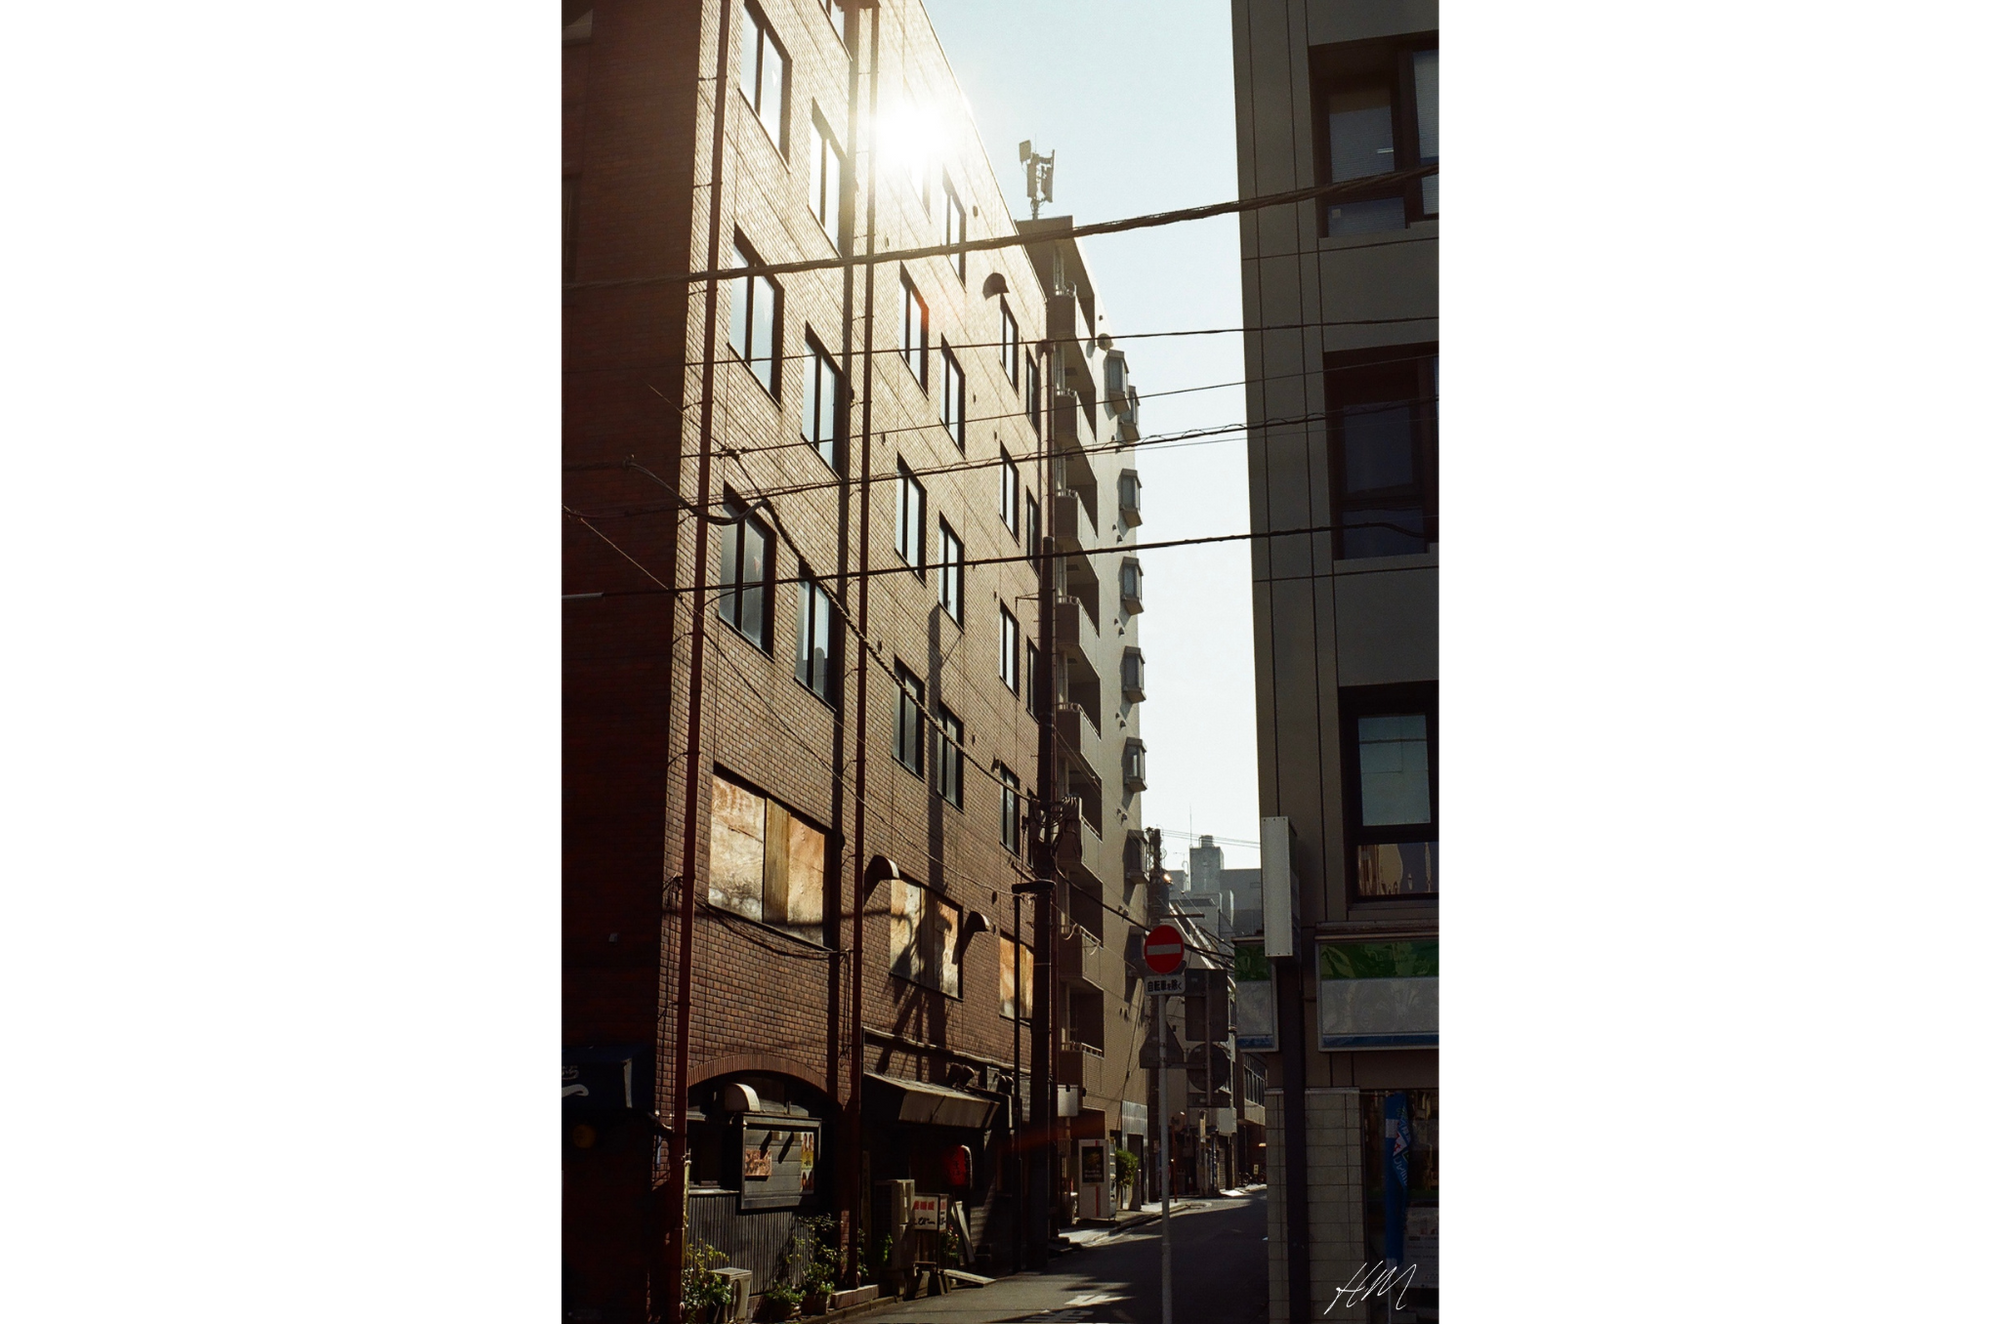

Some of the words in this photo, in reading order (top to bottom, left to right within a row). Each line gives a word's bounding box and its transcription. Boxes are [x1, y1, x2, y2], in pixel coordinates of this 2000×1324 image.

[1147, 979, 1182, 992] 自転車を除く
